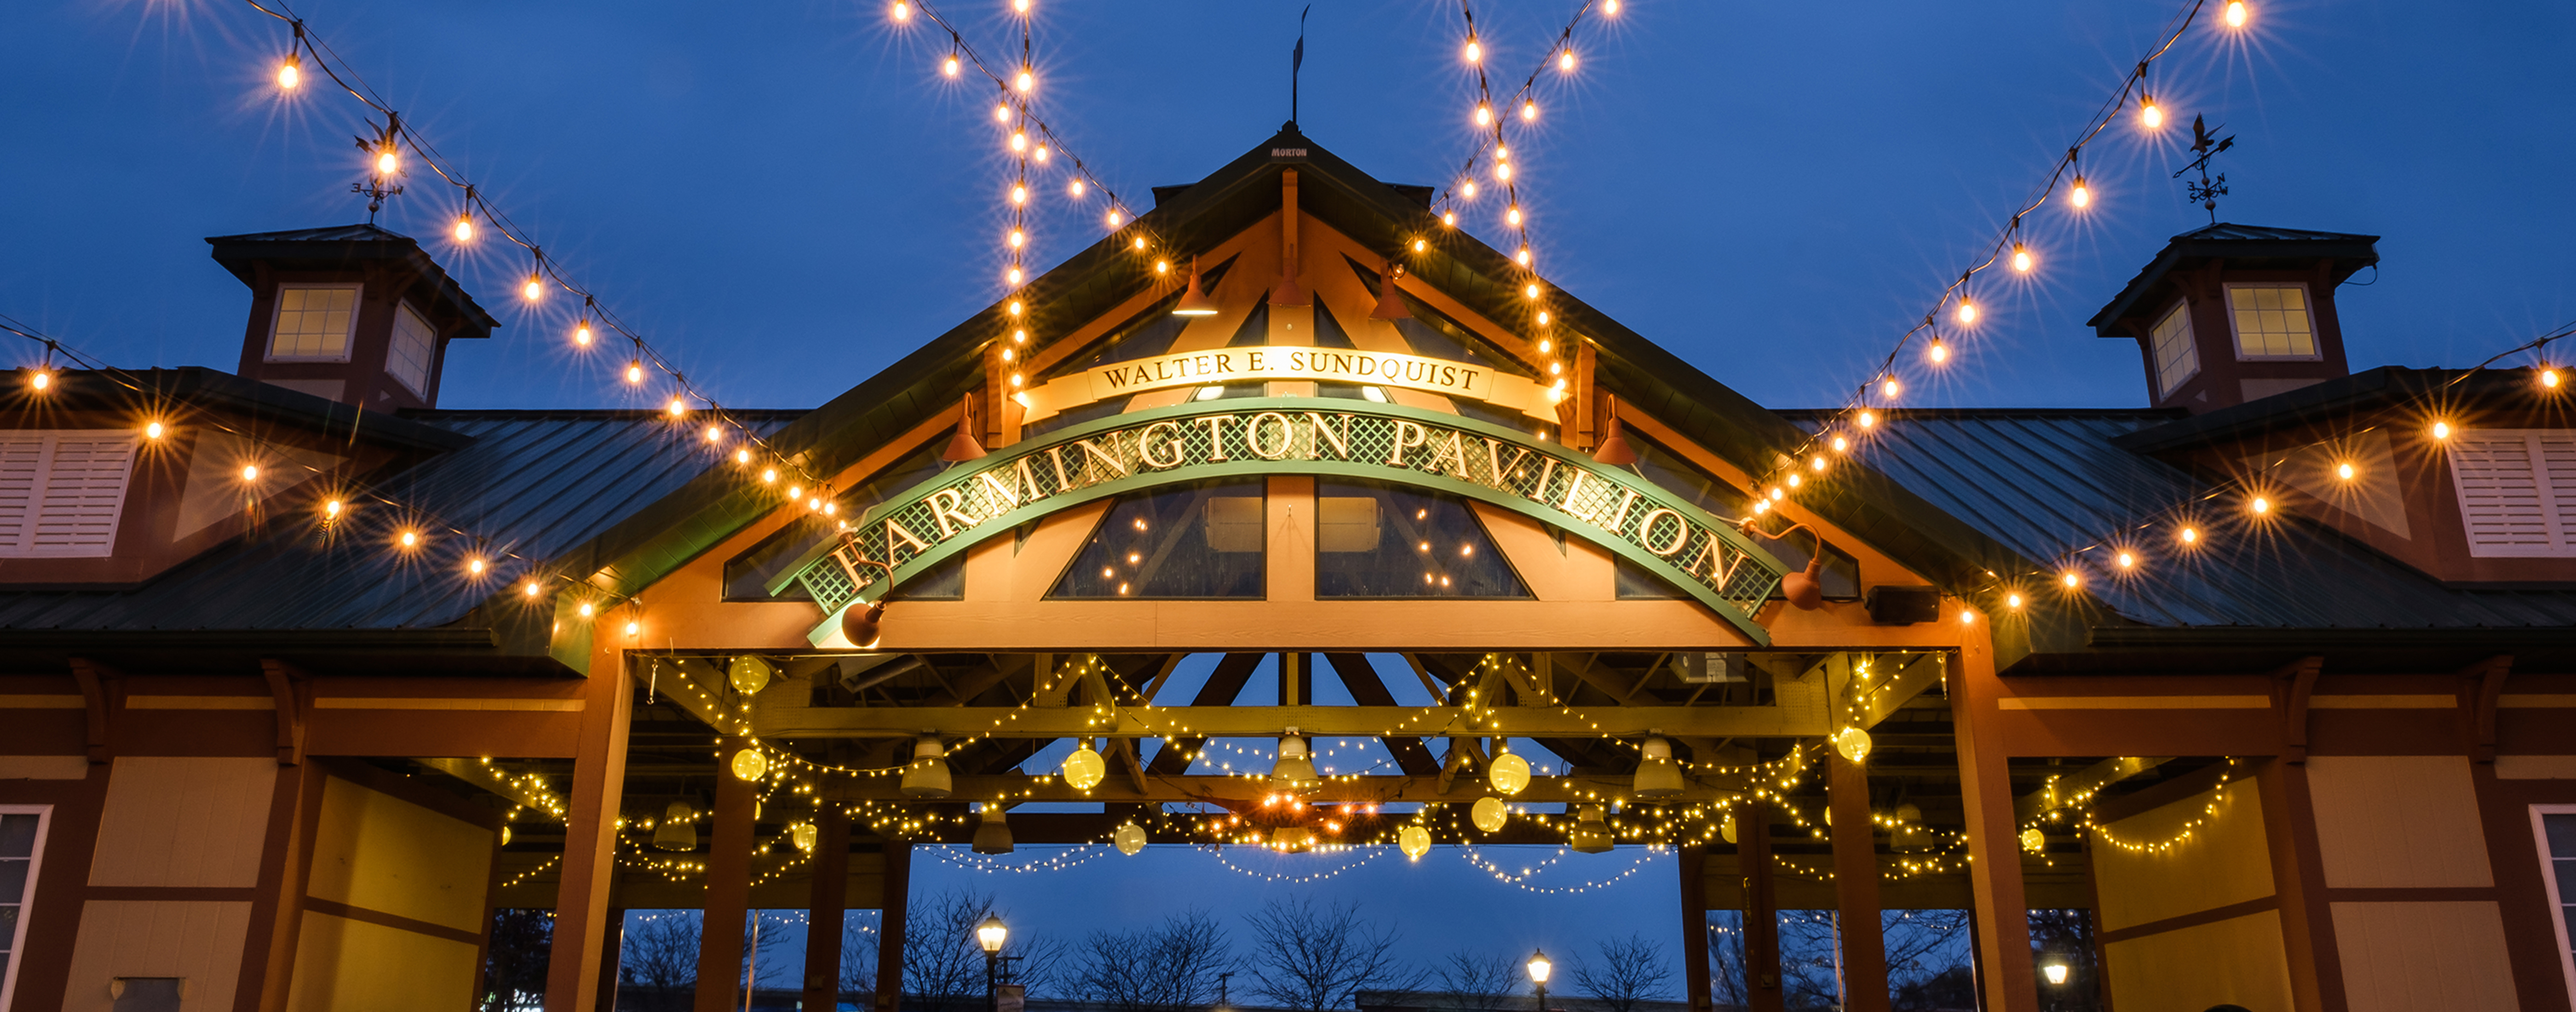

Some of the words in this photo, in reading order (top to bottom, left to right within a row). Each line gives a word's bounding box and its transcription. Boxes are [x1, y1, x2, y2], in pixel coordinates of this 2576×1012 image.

[1271, 148, 1307, 156] MORTON
[1103, 354, 1234, 389] WALTER
[1248, 352, 1274, 371] E.
[1290, 351, 1478, 390] SUNDQUIST
[829, 412, 1355, 593] FARMINGTON
[1386, 419, 1750, 592] PAVILION
